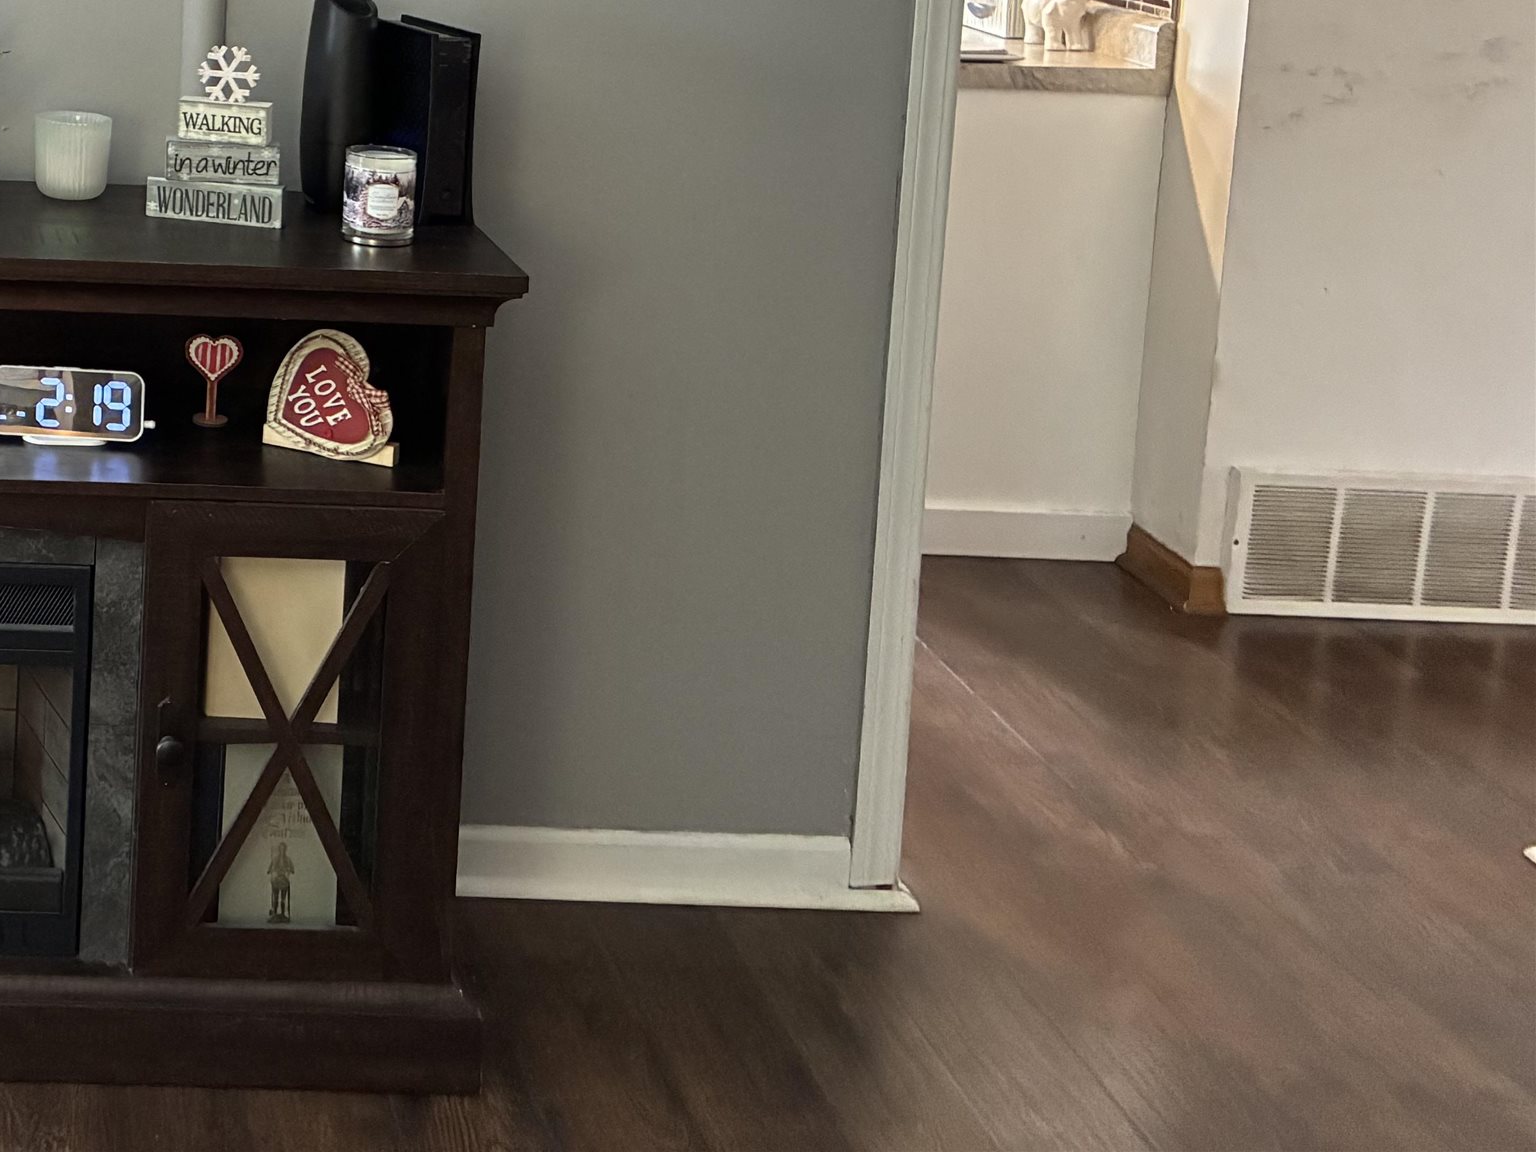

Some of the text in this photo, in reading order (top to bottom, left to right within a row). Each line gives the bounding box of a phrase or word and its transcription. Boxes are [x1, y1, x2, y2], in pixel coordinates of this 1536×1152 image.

[181, 111, 263, 136] WALKING
[173, 152, 279, 178] in a winter
[157, 185, 273, 224] WONDERLAND
[35, 377, 132, 432] 2:19
[287, 384, 325, 427] YOU
[304, 364, 353, 427] LOVE
